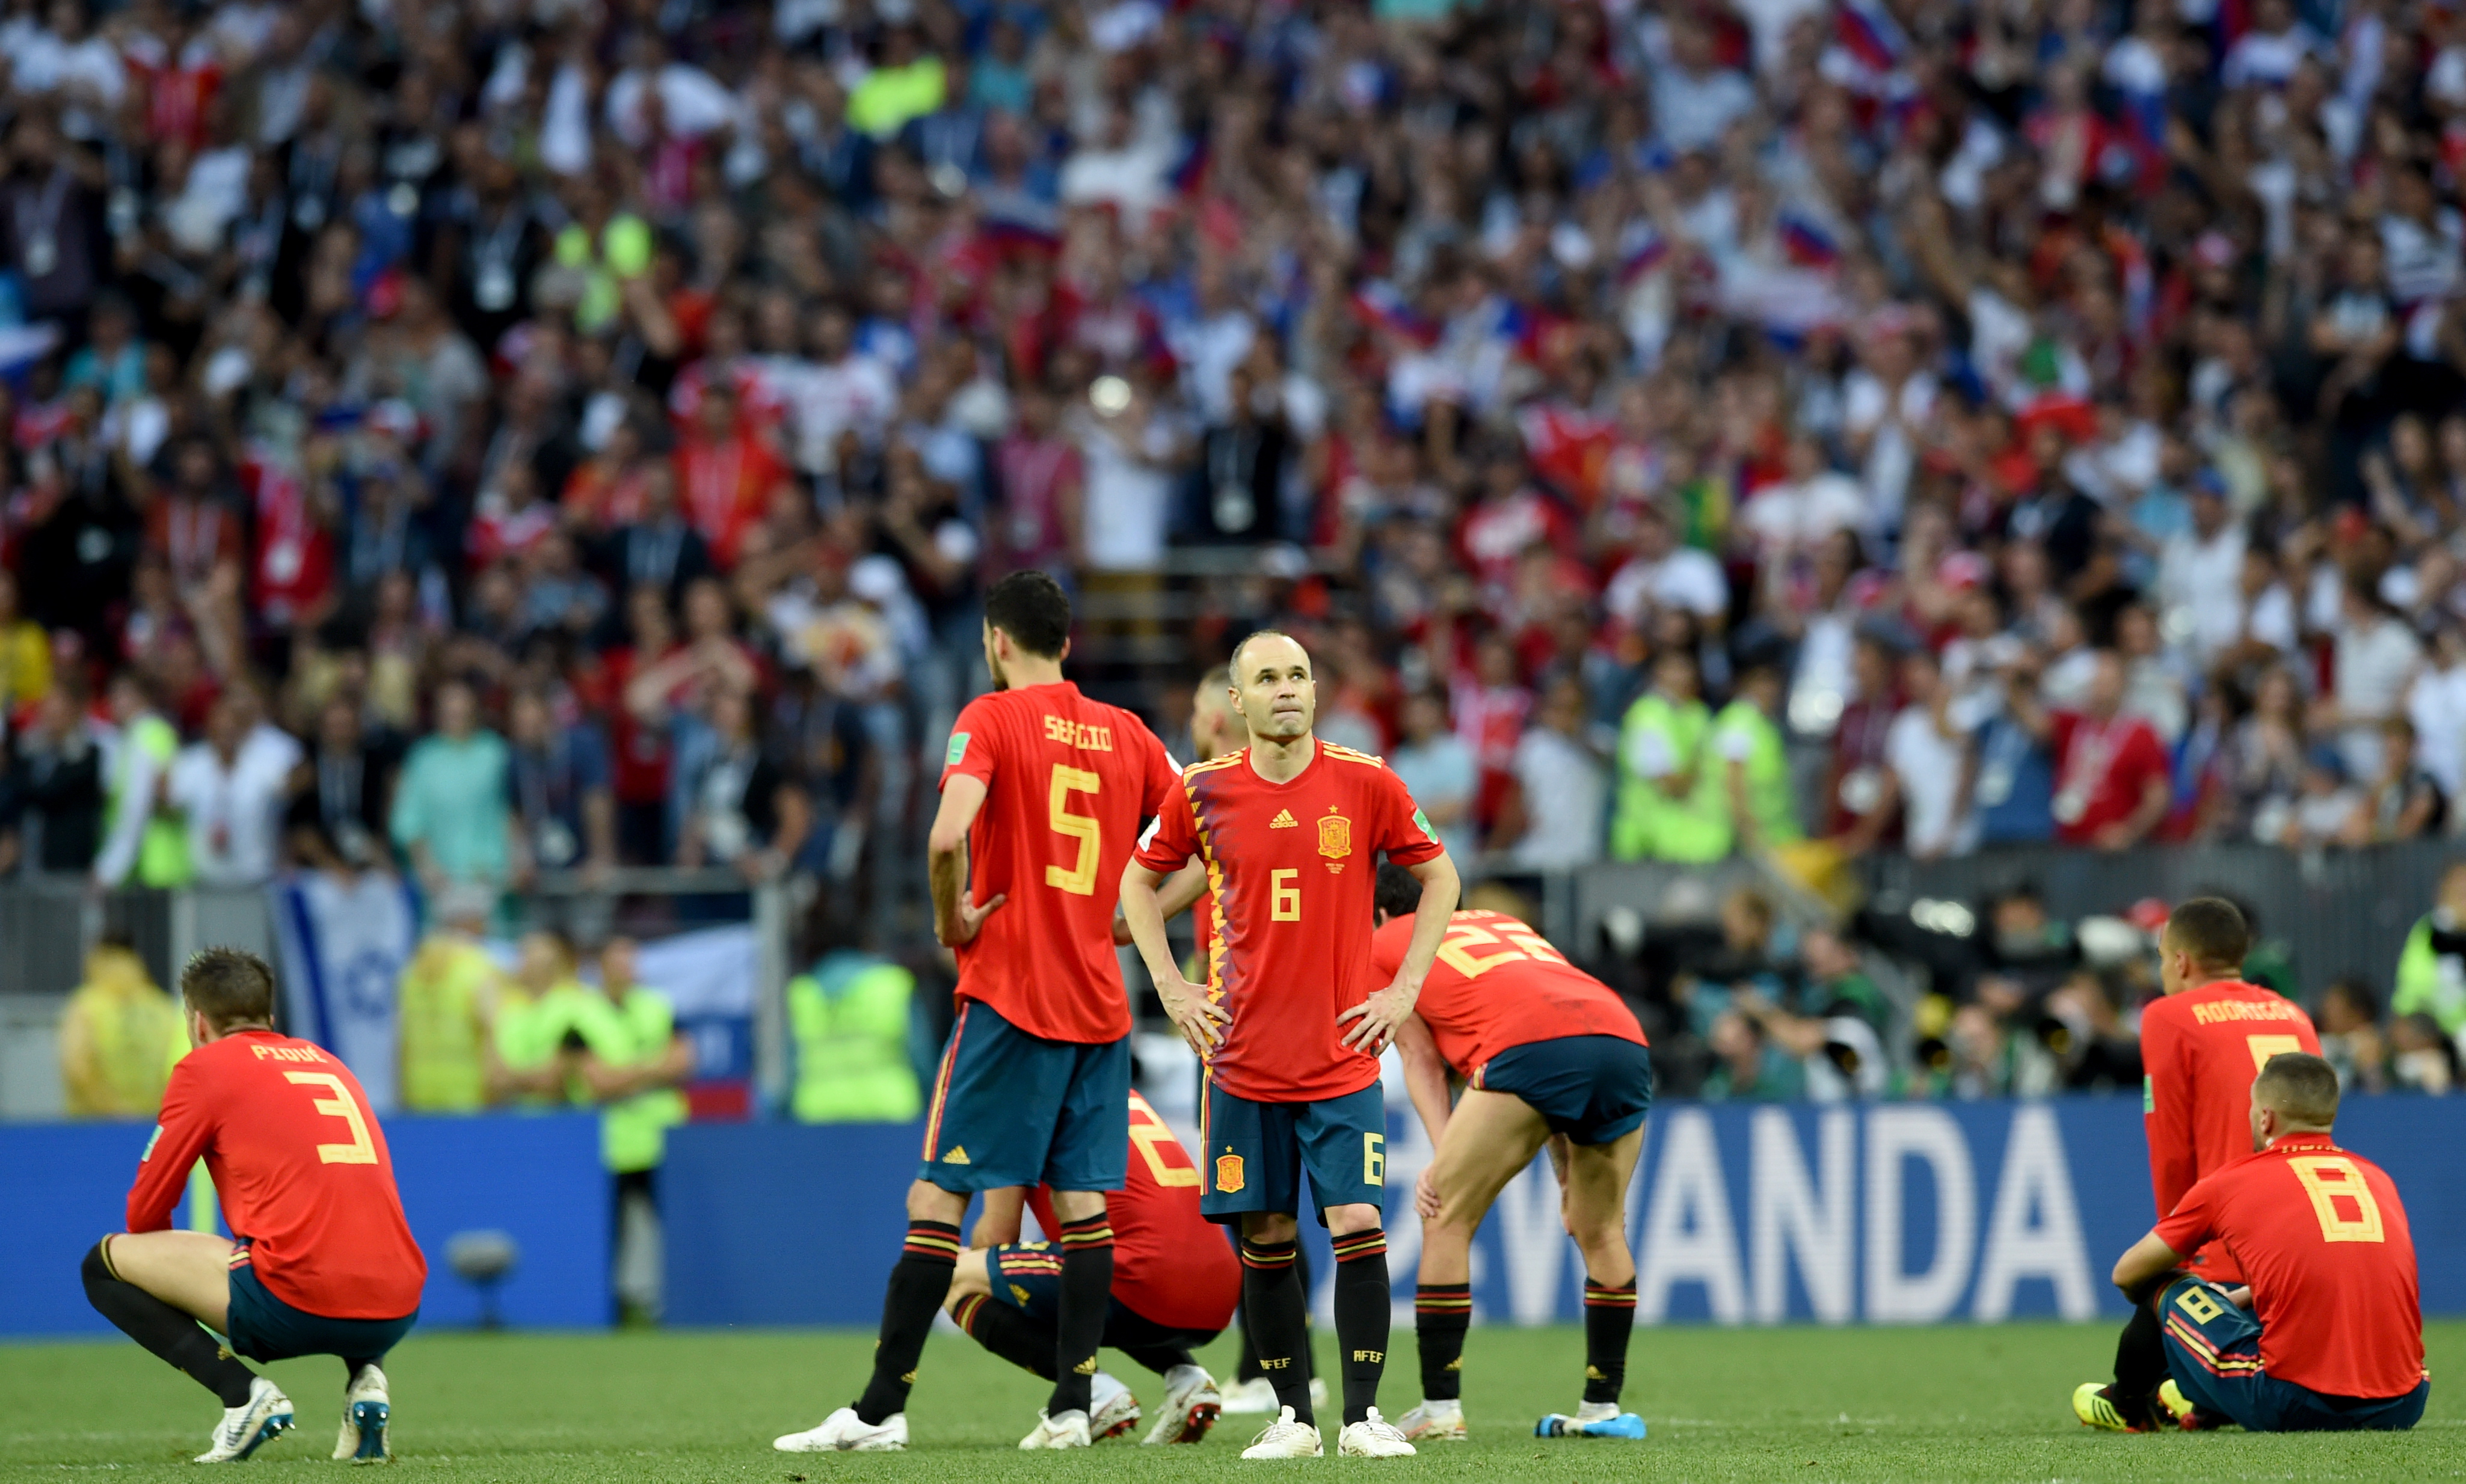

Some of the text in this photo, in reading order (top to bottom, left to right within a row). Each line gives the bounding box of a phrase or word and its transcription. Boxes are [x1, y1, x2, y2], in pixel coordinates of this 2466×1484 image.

[1045, 763, 1101, 896] 5
[1271, 868, 1300, 921] 6
[282, 1071, 379, 1165] 3
[1364, 1132, 1384, 1186] 6
[2286, 1155, 2385, 1243] 8
[2175, 1285, 2224, 1325] 8
